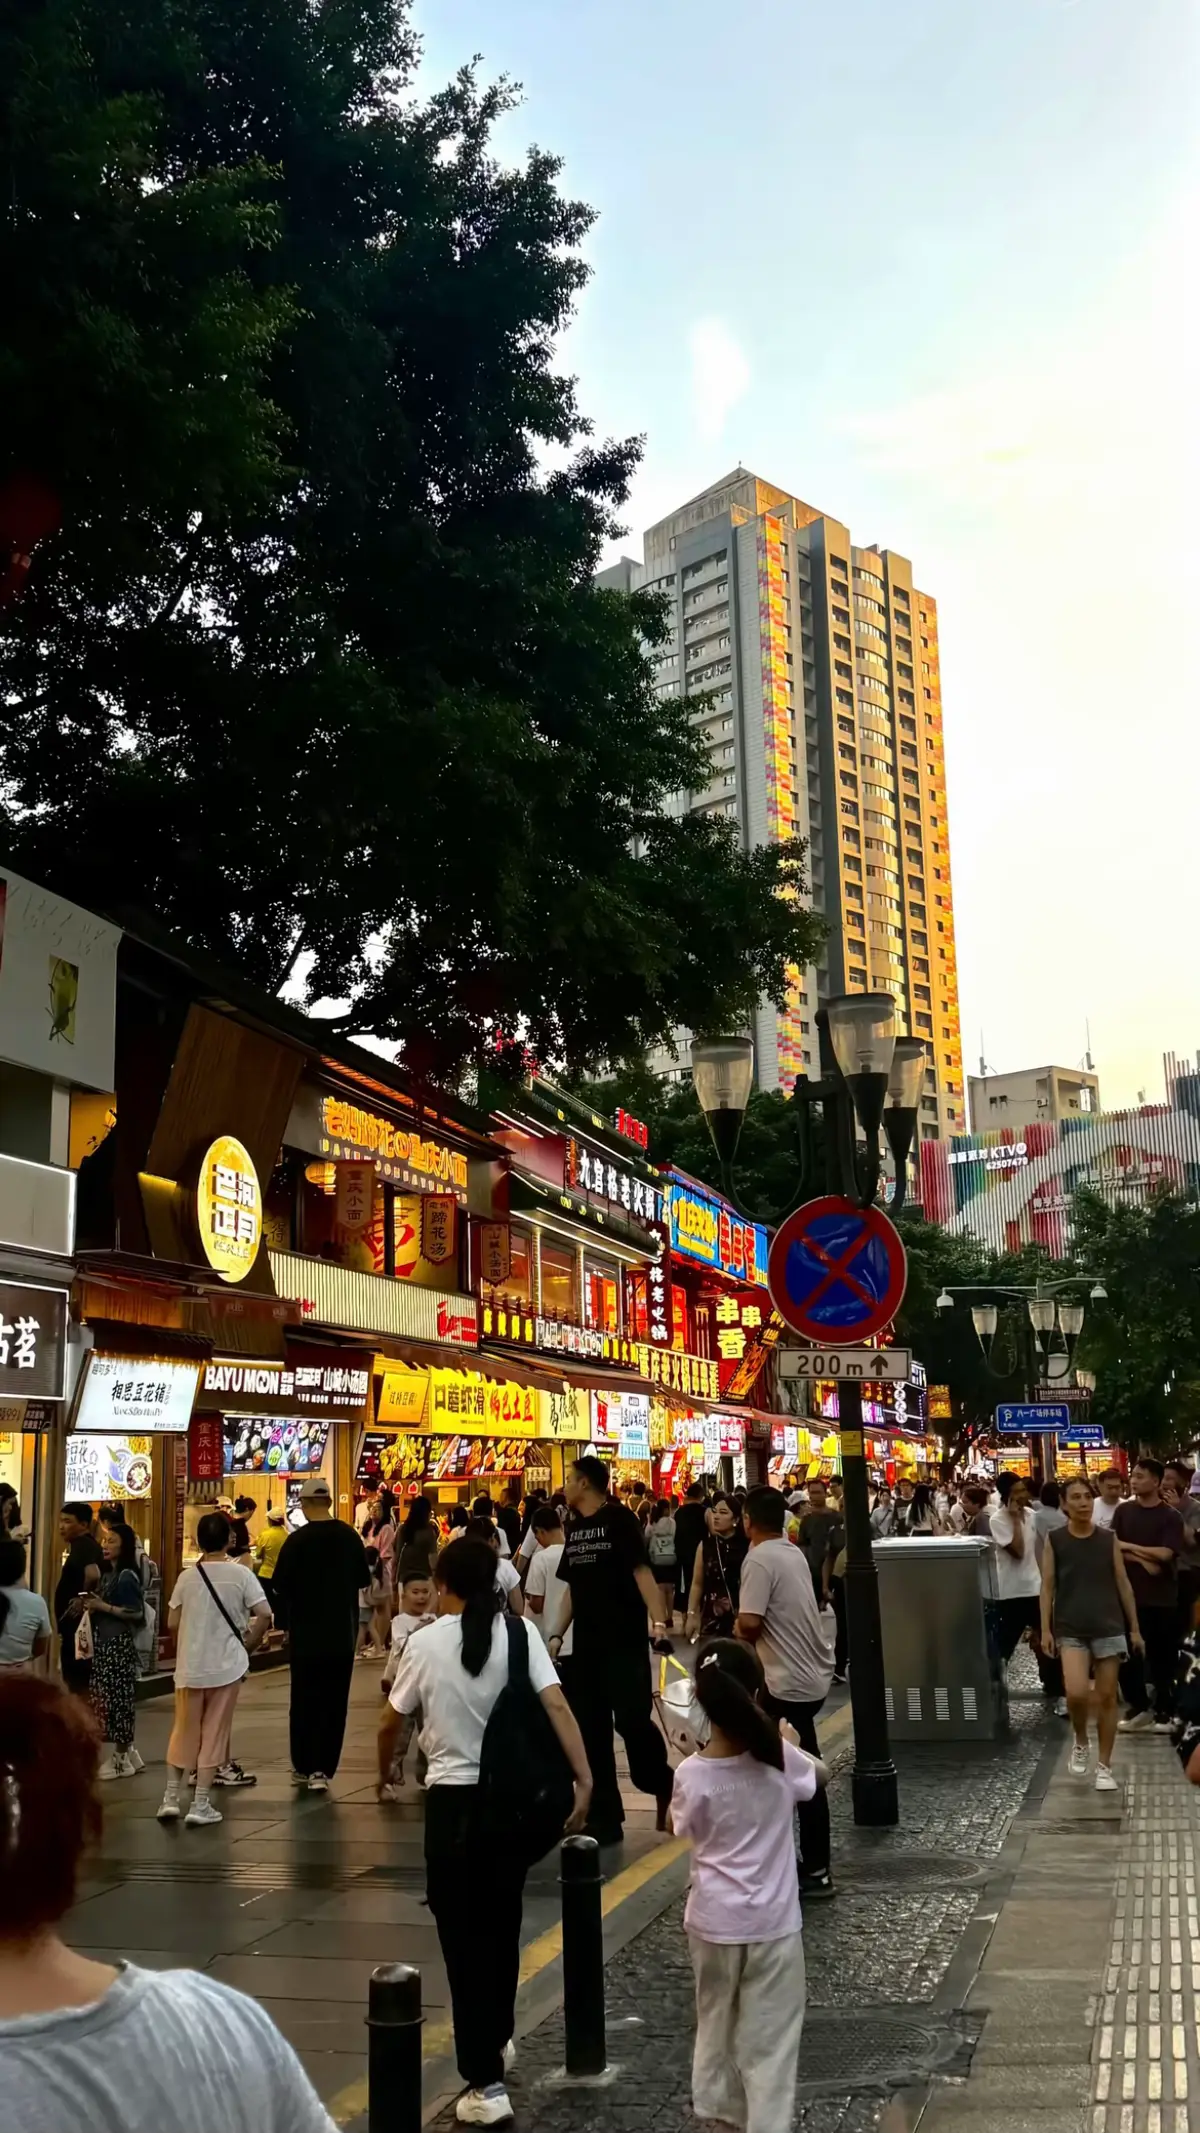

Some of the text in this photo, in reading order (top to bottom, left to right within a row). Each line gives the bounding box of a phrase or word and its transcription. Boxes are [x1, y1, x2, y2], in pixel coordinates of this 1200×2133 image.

[991, 1145, 1016, 1159] KTV
[346, 1170, 364, 1221] 重庆小面
[579, 1149, 655, 1222] 九宫格老火锅
[430, 1210, 448, 1256] 蹄花汤
[717, 1328, 747, 1360] 香
[204, 1365, 280, 1396] BAYU MOON
[323, 1366, 370, 1395] 山城小汤圆
[797, 1354, 864, 1376] 200 m
[111, 1380, 167, 1404] 相思豆花铺
[1016, 1407, 1063, 1418] 八一广场停车场
[197, 1422, 213, 1475] 重庆小面
